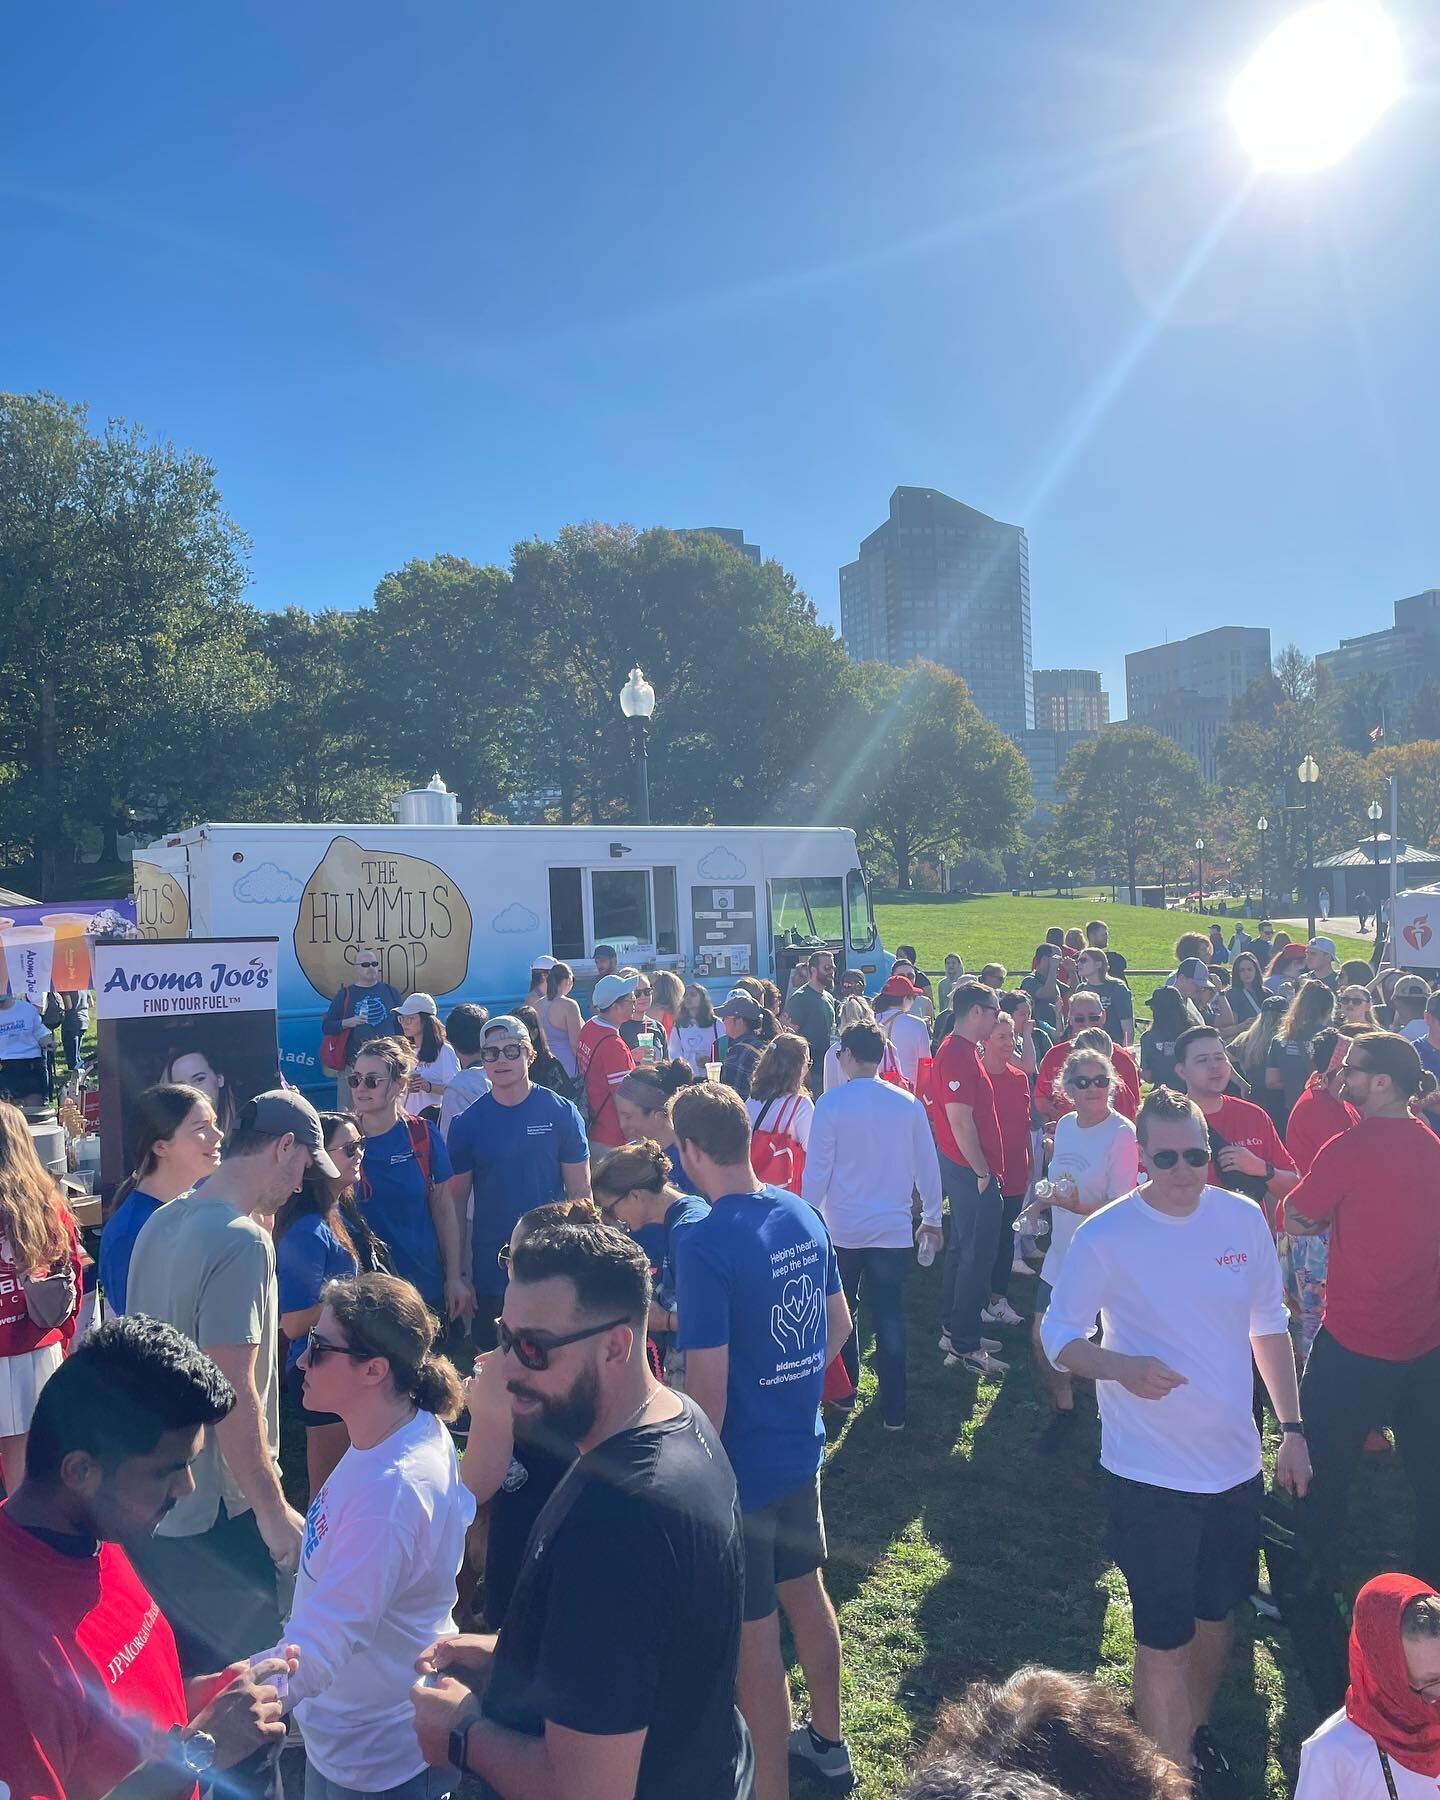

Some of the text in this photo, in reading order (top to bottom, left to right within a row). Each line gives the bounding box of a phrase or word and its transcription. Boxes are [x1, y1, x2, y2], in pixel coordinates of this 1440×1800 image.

[361, 861, 398, 884] THE
[308, 885, 452, 943] HUMMUS
[103, 967, 203, 993] Aroma
[143, 998, 169, 1013] FIND
[172, 997, 201, 1011] YOUR
[769, 1246, 796, 1265] Helping
[1215, 1253, 1248, 1266] verve
[772, 1264, 789, 1279] keep
[789, 1259, 802, 1271] the
